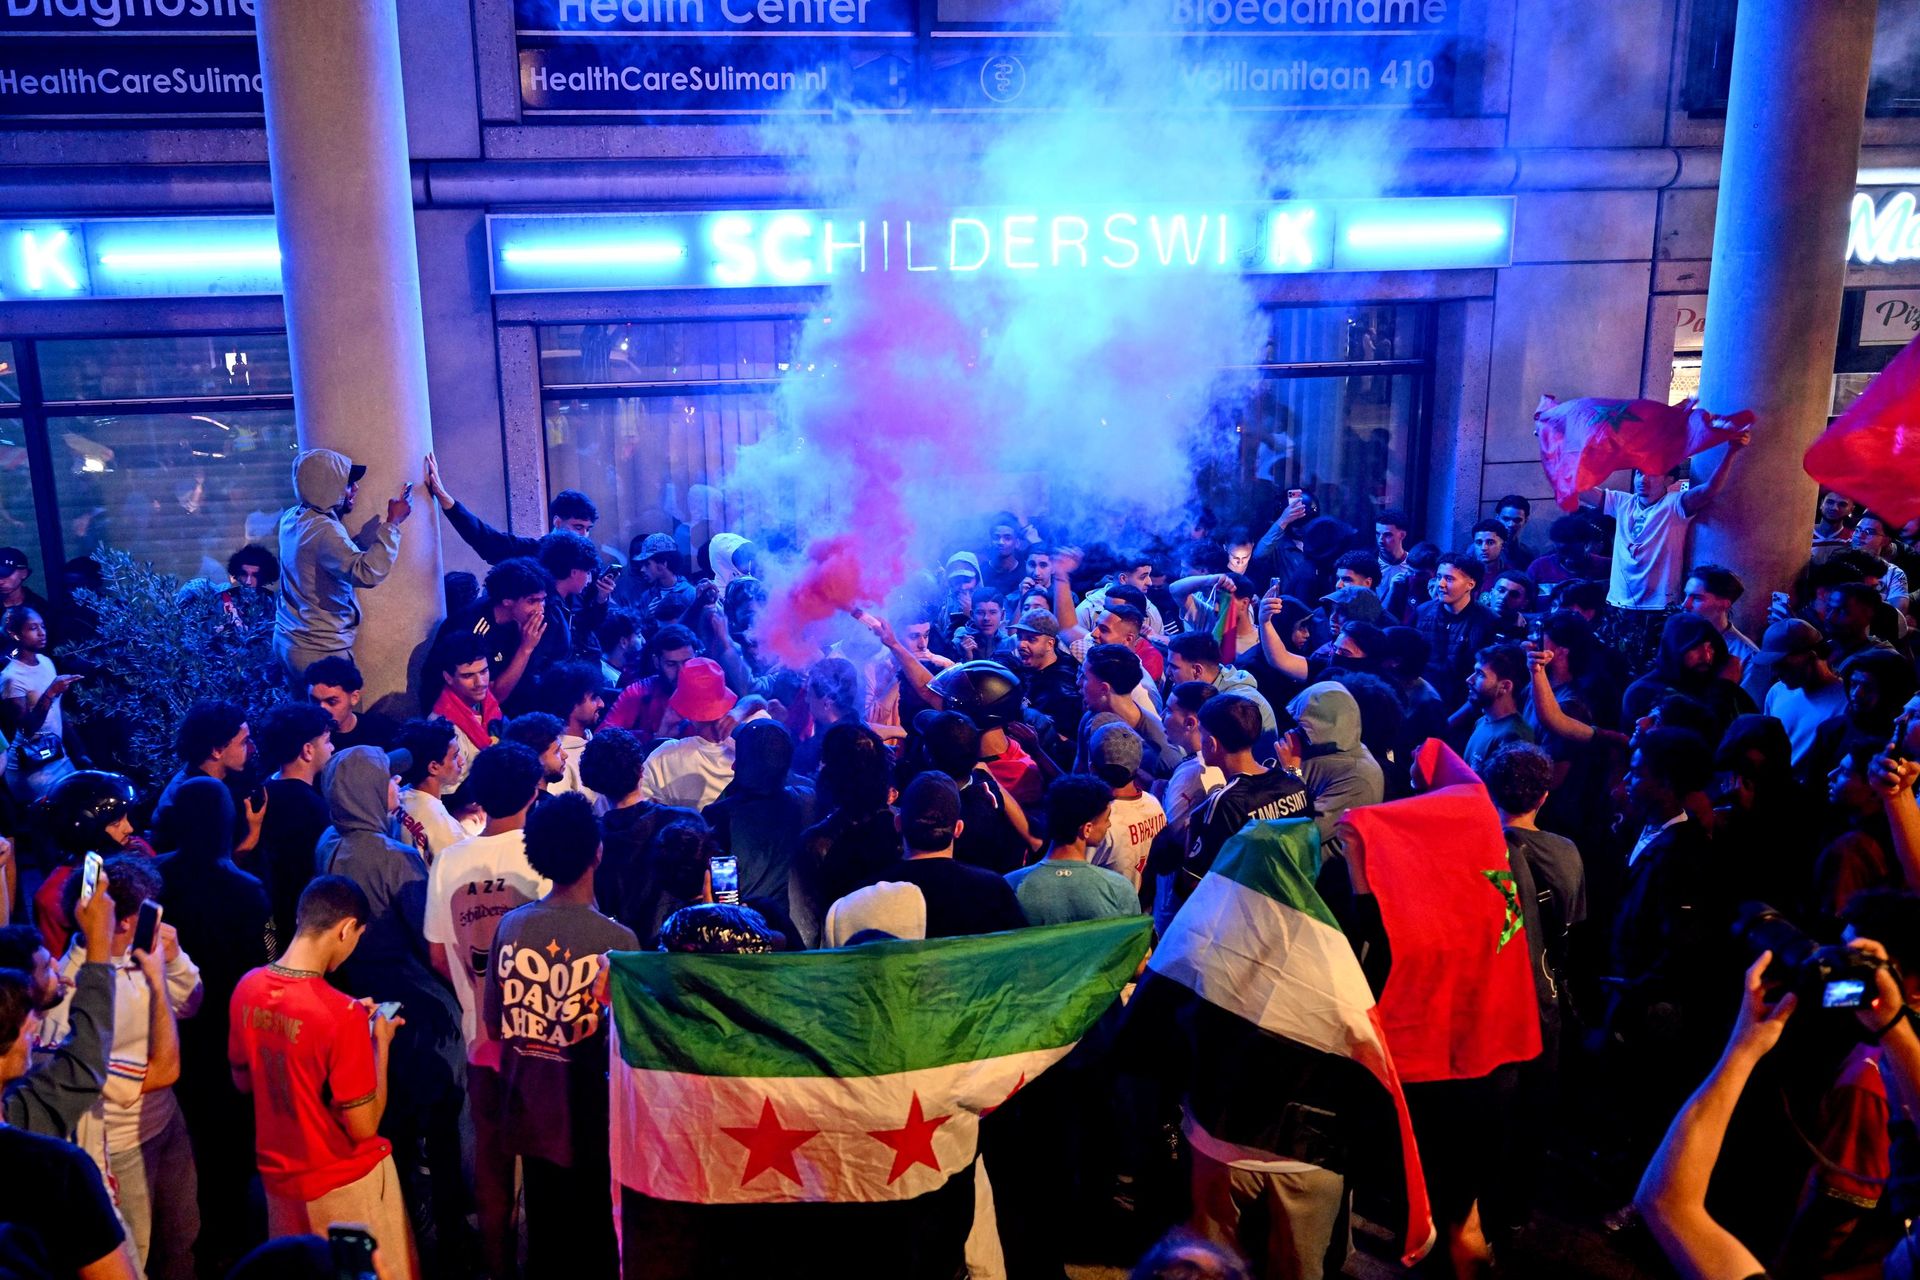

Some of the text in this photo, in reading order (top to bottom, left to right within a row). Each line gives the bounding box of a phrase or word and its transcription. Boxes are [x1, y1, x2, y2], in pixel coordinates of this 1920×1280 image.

[559, 0, 870, 24] Health Center
[1180, 60, 1435, 92] Vaillantlaan 410
[1248, 790, 1307, 820] TAMASSINT
[498, 944, 600, 999] GOOD
[503, 979, 582, 1022] DAYS
[501, 1007, 599, 1047] AHEAD
